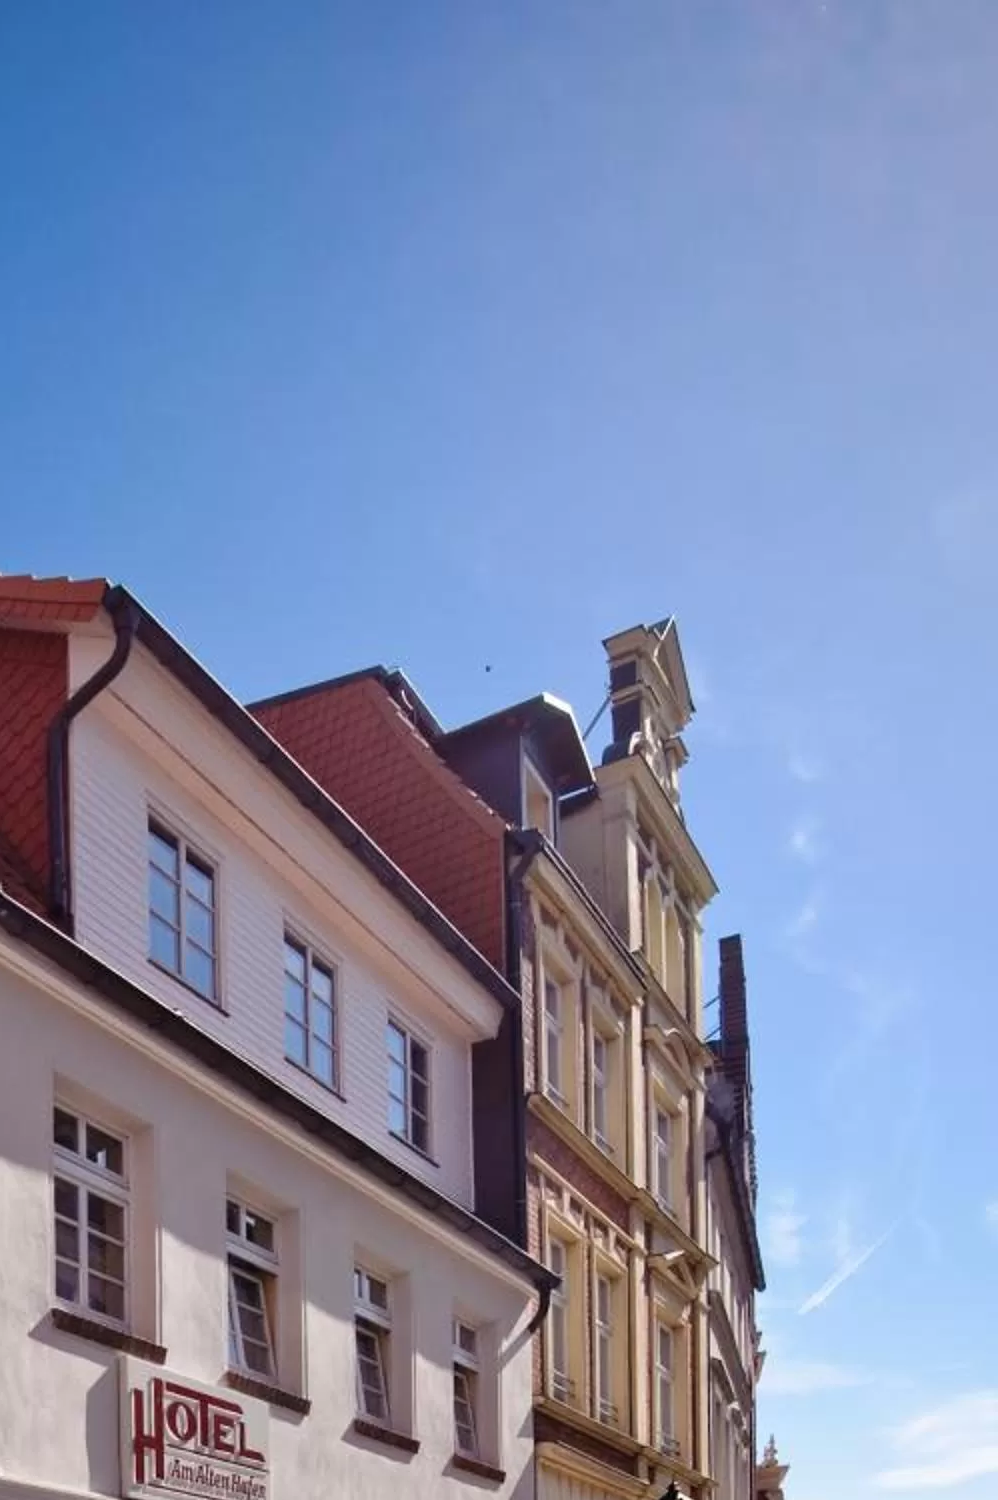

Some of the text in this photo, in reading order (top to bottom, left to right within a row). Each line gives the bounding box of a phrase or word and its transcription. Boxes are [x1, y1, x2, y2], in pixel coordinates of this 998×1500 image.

[133, 1377, 266, 1484] HOTEL
[171, 1459, 266, 1500] Am Alten Hafen
